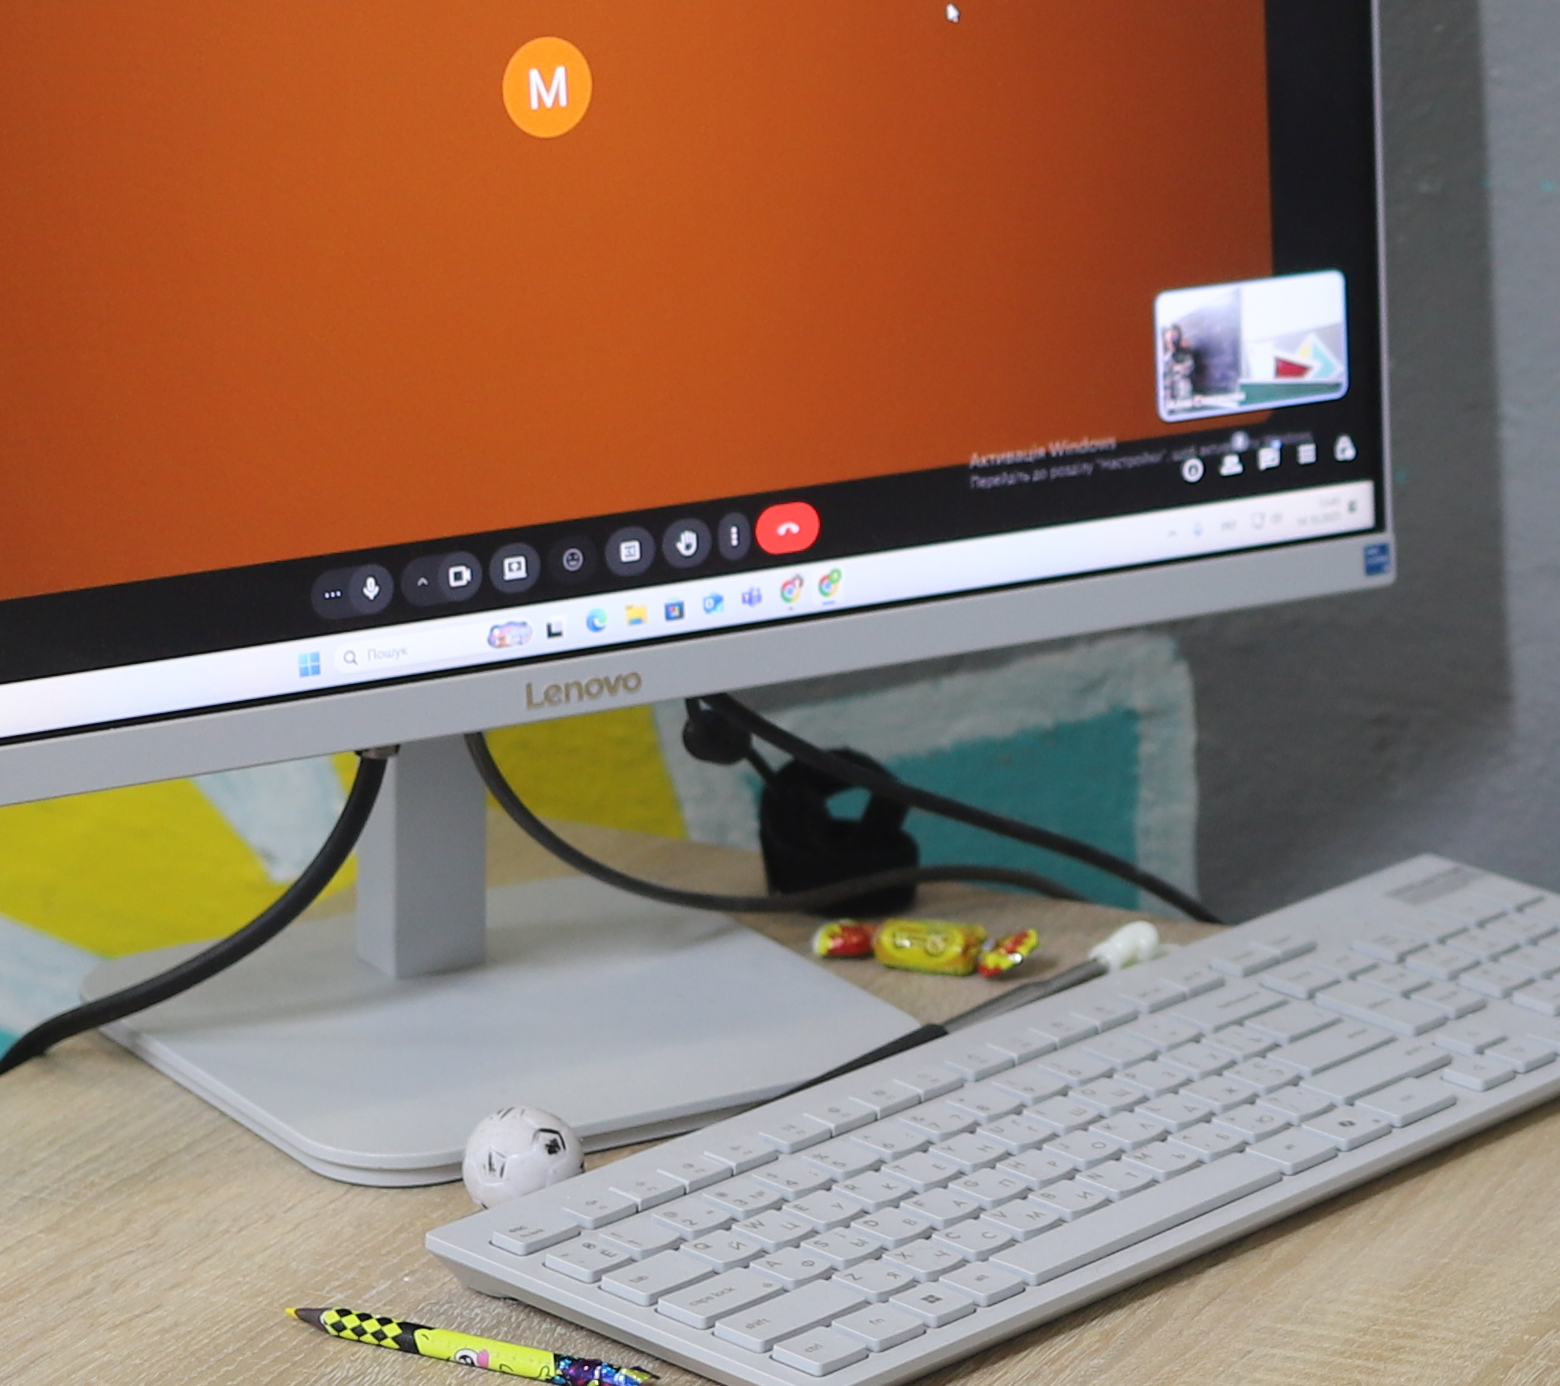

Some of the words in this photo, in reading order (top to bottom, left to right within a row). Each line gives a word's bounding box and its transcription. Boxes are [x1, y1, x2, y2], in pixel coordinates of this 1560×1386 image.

[529, 65, 568, 110] М
[525, 672, 643, 710] Lenovo
[745, 1316, 770, 1330] shift
[804, 1342, 824, 1354] ctrl
[869, 1316, 885, 1327] fn
